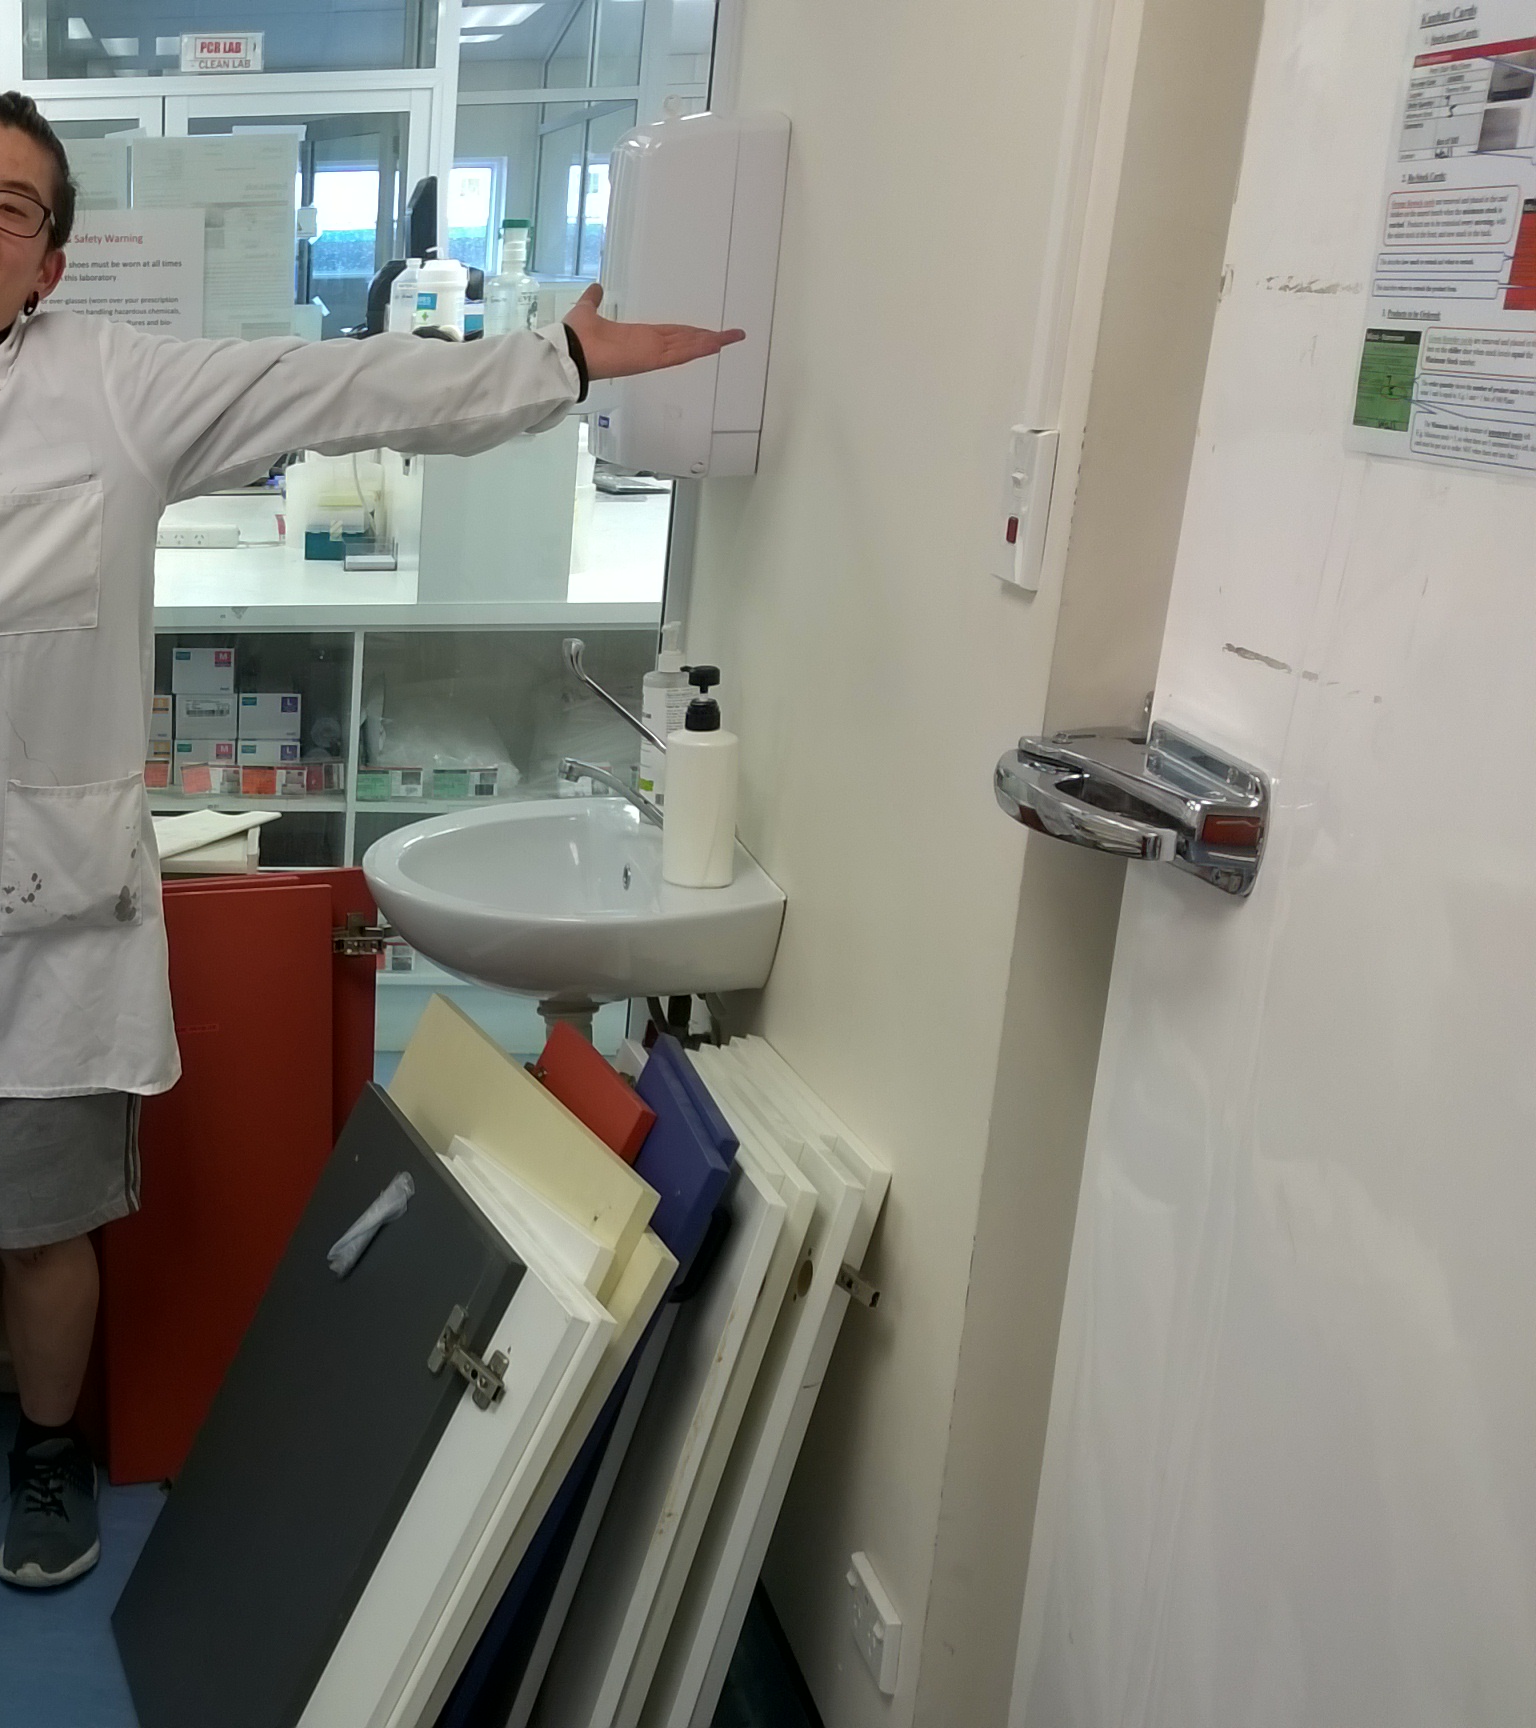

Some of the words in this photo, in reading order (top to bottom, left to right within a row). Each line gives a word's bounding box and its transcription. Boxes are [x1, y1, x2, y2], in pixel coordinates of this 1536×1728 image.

[200, 41, 220, 53] PCR
[223, 41, 241, 53] LAB
[199, 60, 229, 69] CLEAN
[232, 60, 251, 68] LAB
[74, 234, 103, 245] Safety
[104, 234, 143, 245] Warning
[69, 261, 89, 269] shoes
[111, 260, 120, 268] be
[142, 260, 150, 268] at
[64, 274, 78, 282] this
[79, 274, 116, 282] laboratory
[89, 297, 108, 305] (worn
